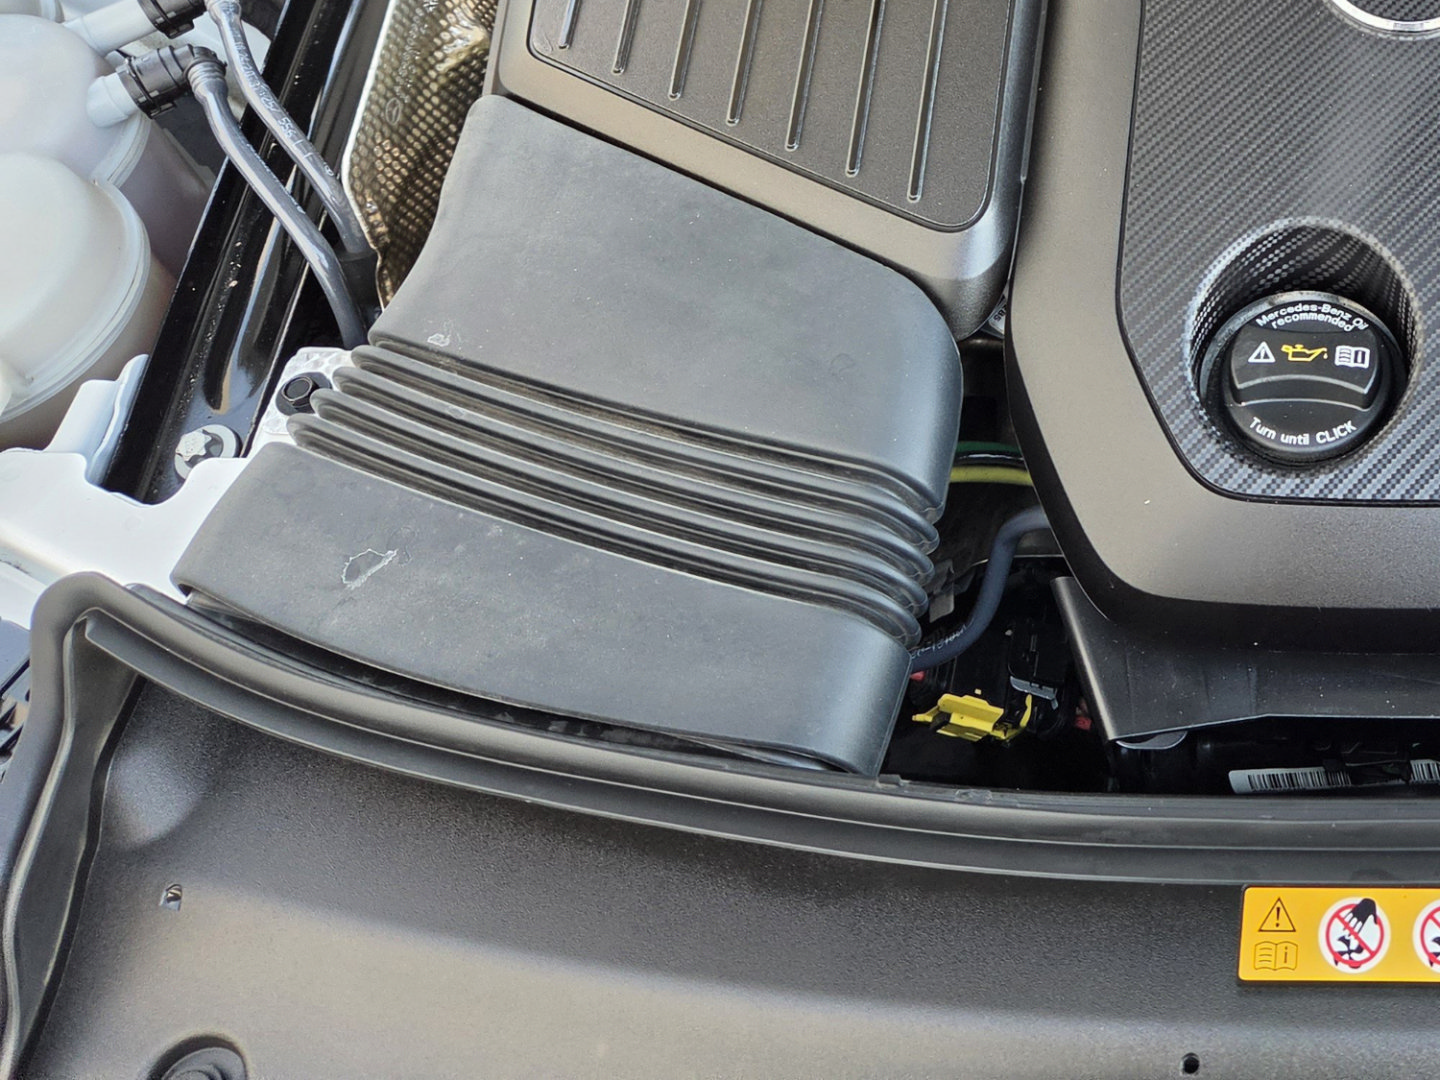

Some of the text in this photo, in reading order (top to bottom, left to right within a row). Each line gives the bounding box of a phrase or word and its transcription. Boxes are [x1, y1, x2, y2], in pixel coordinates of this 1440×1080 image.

[1255, 302, 1370, 331] Mercedes-Benz Oil
[1271, 311, 1356, 333] recommended
[1249, 416, 1357, 445] Turn until CLICK
